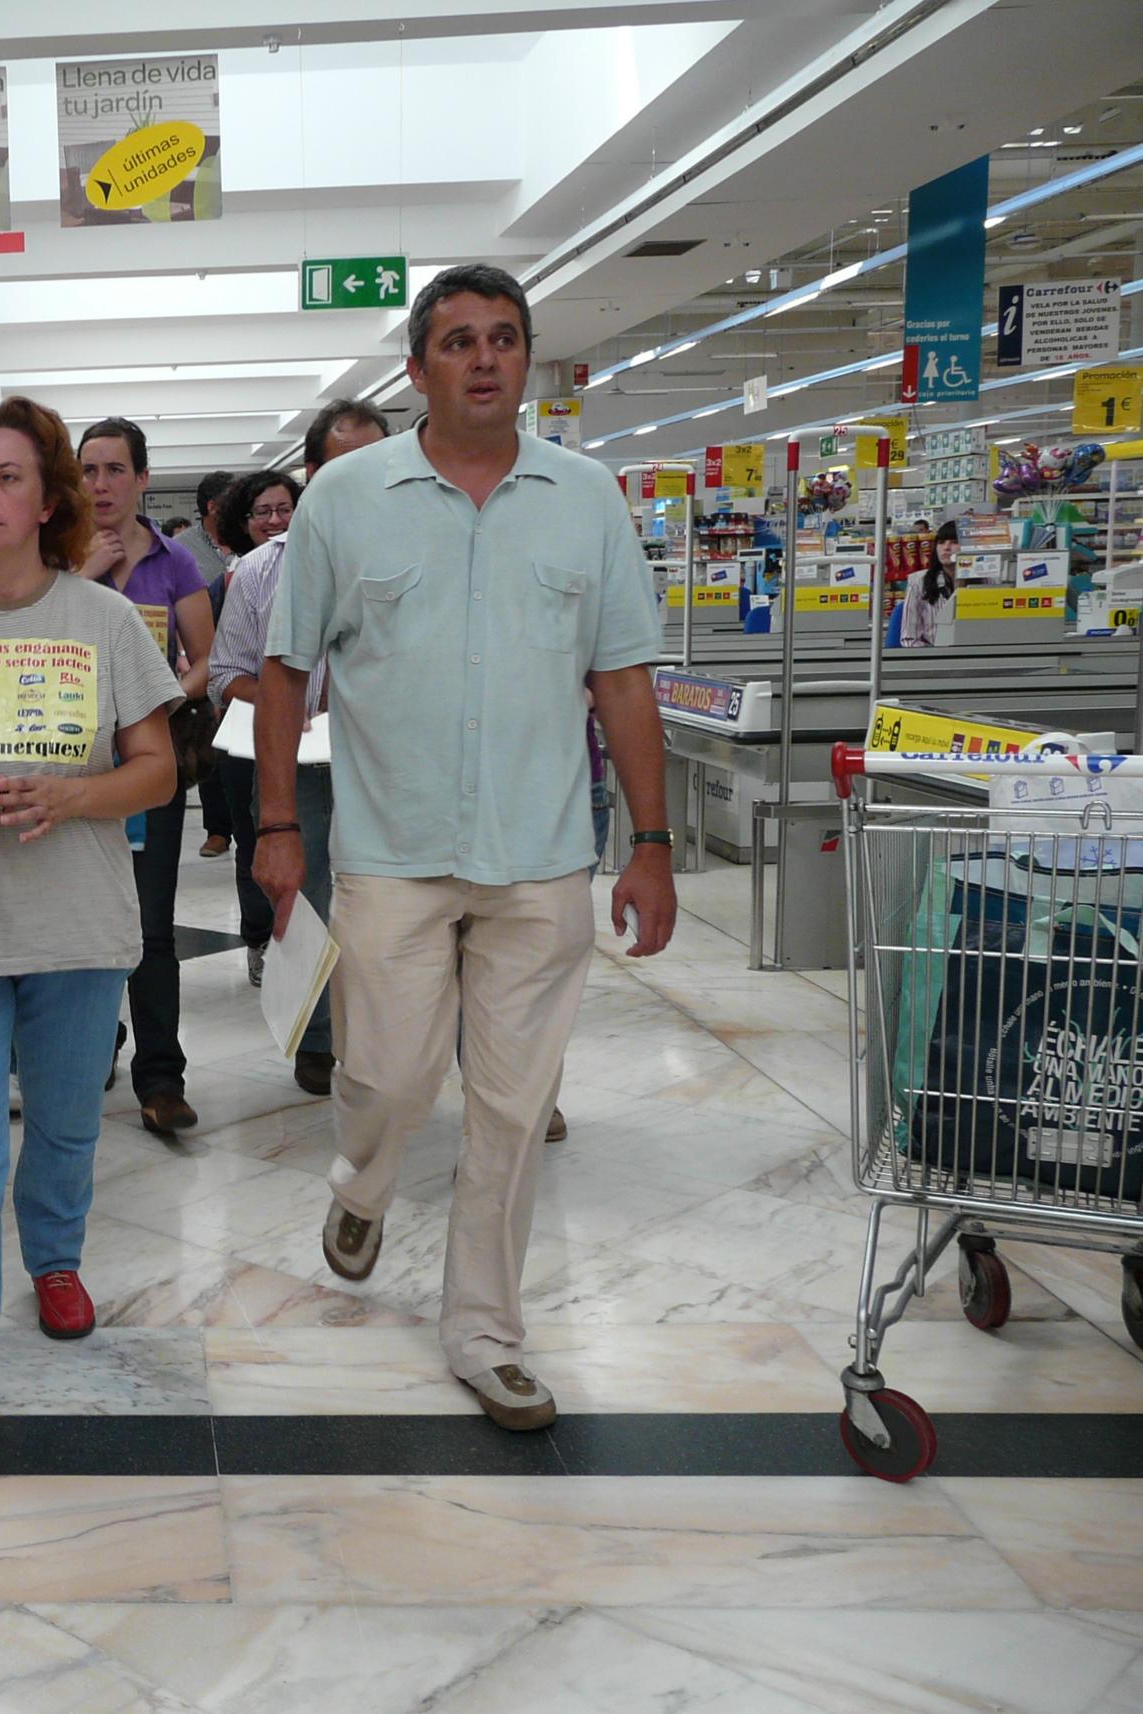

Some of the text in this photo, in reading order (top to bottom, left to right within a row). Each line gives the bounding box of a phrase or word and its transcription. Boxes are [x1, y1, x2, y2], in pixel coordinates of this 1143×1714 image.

[62, 59, 216, 89] Llena de vida
[63, 90, 163, 120] tu jardín
[121, 132, 181, 173] últimas
[122, 144, 196, 193] unidades
[1026, 284, 1094, 298] Carrefour
[1053, 300, 1068, 308] POR
[1070, 299, 1080, 307] LA
[937, 320, 951, 330] por
[1082, 371, 1138, 380] Promoción
[1101, 397, 1115, 427] 1
[890, 450, 905, 461] 29
[6, 656, 47, 669] sector
[14, 642, 91, 660] engánante
[671, 681, 712, 711] BARATOS
[693, 773, 734, 801] Crefour
[1033, 1052, 1143, 1087] UNA MANO
[1027, 1075, 1143, 1110] AL MEDIO
[1020, 1097, 1141, 1132] AMBIENTE
